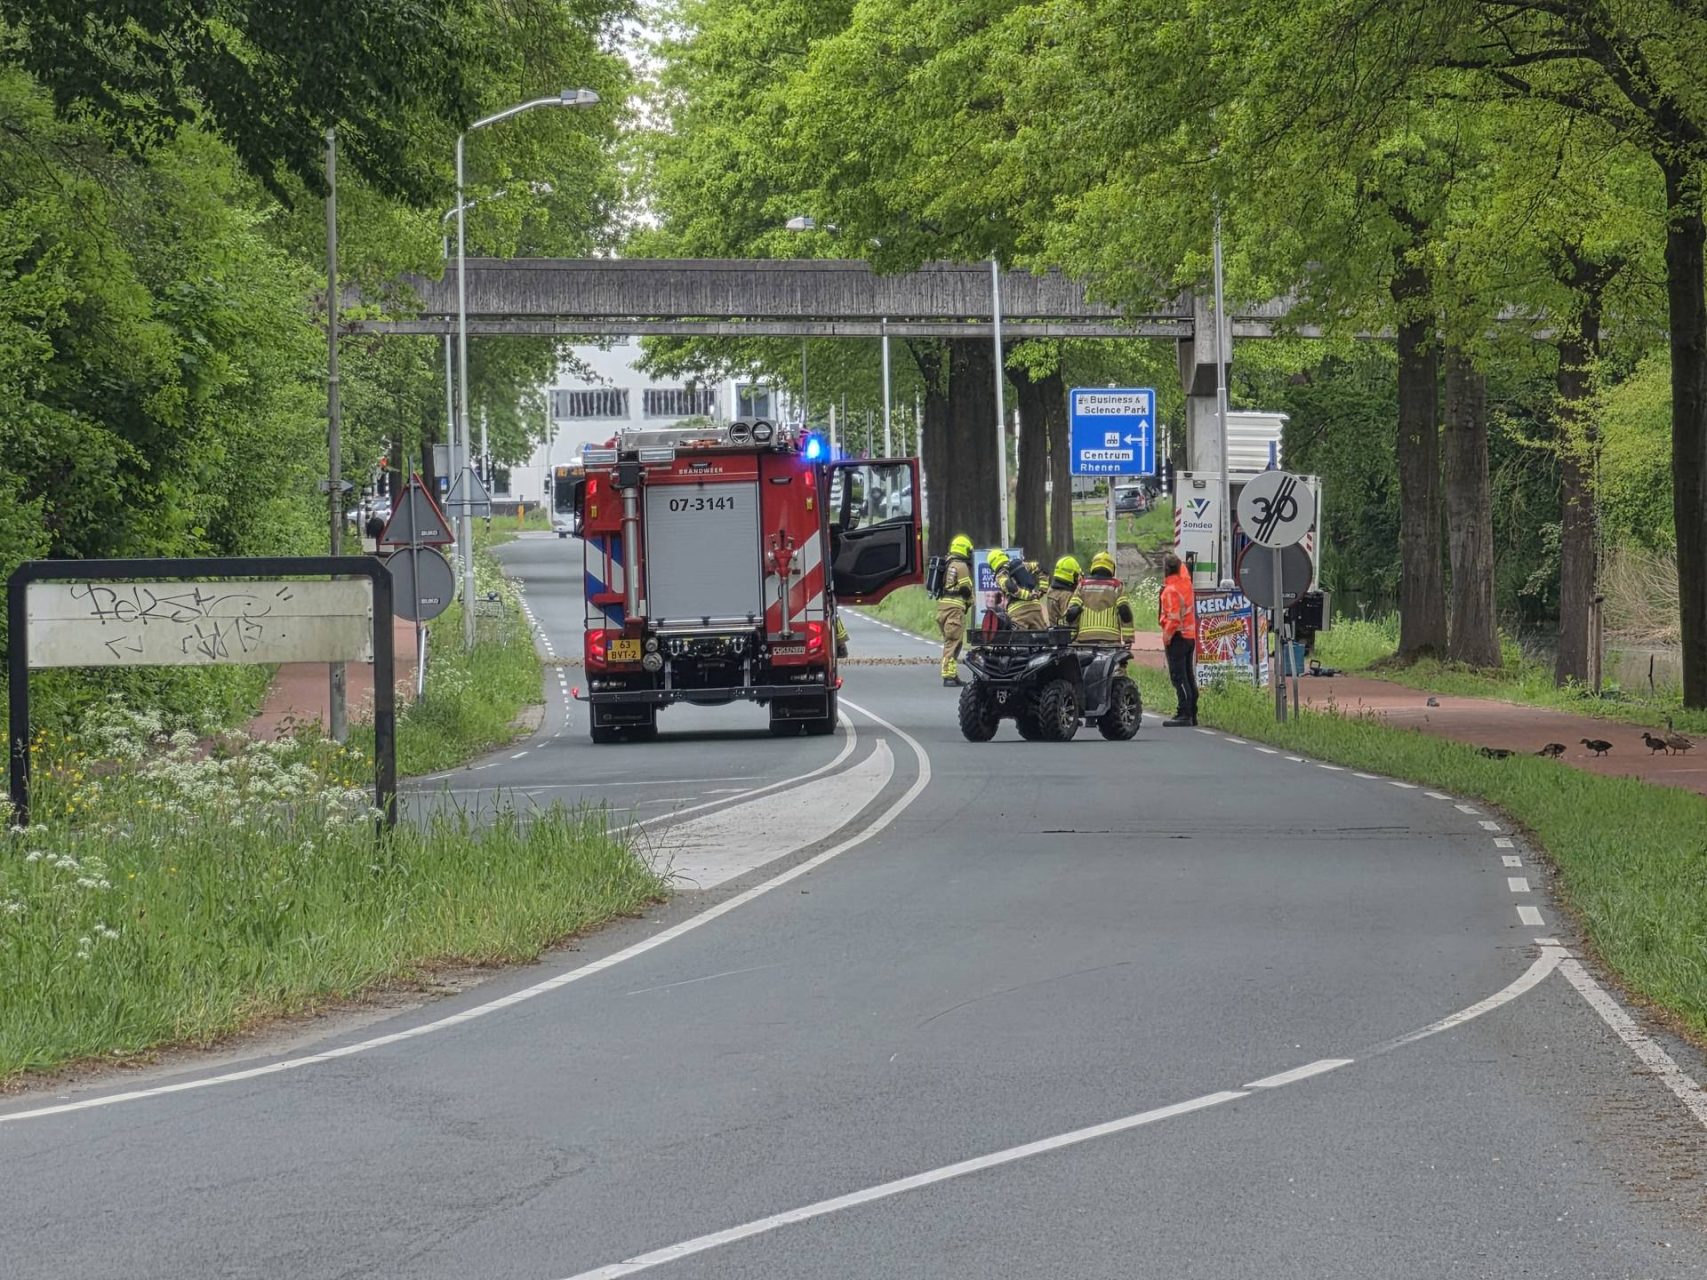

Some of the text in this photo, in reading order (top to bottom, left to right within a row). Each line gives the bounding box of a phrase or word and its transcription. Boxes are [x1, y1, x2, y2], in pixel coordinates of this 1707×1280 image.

[1090, 395, 1133, 404] Business
[1084, 405, 1147, 414] Science Park
[1083, 451, 1130, 460] Centrum
[678, 467, 724, 475] BRANDWEER
[1080, 463, 1121, 472] Rhenen
[669, 496, 735, 512] 07-3141
[1251, 495, 1298, 524] 30
[1182, 520, 1213, 529] Sondeo
[1196, 594, 1251, 614] KERMIS
[619, 640, 631, 650] 63
[611, 649, 637, 660] BVT-2
